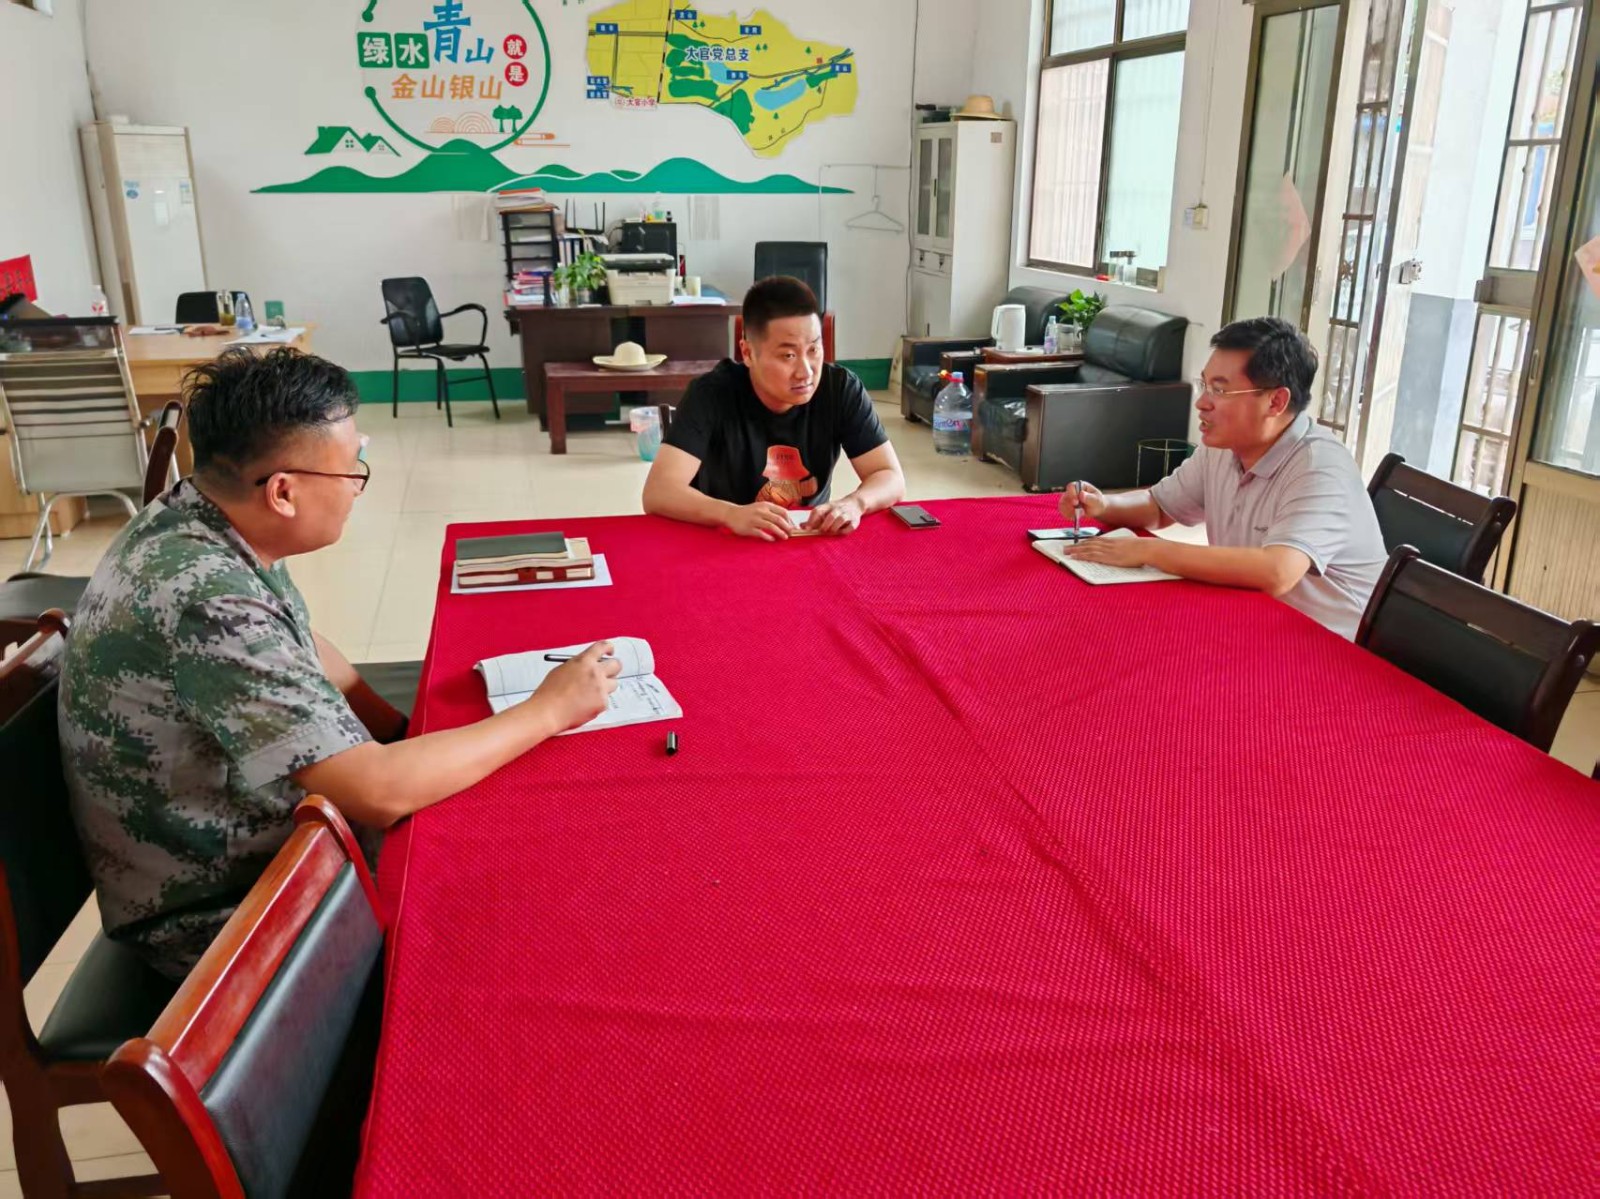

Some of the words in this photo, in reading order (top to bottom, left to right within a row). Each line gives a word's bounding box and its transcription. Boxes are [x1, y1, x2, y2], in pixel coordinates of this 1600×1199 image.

[506, 37, 525, 83] 就是
[686, 46, 750, 62] 大官党总支
[391, 73, 503, 100] 金山银山
